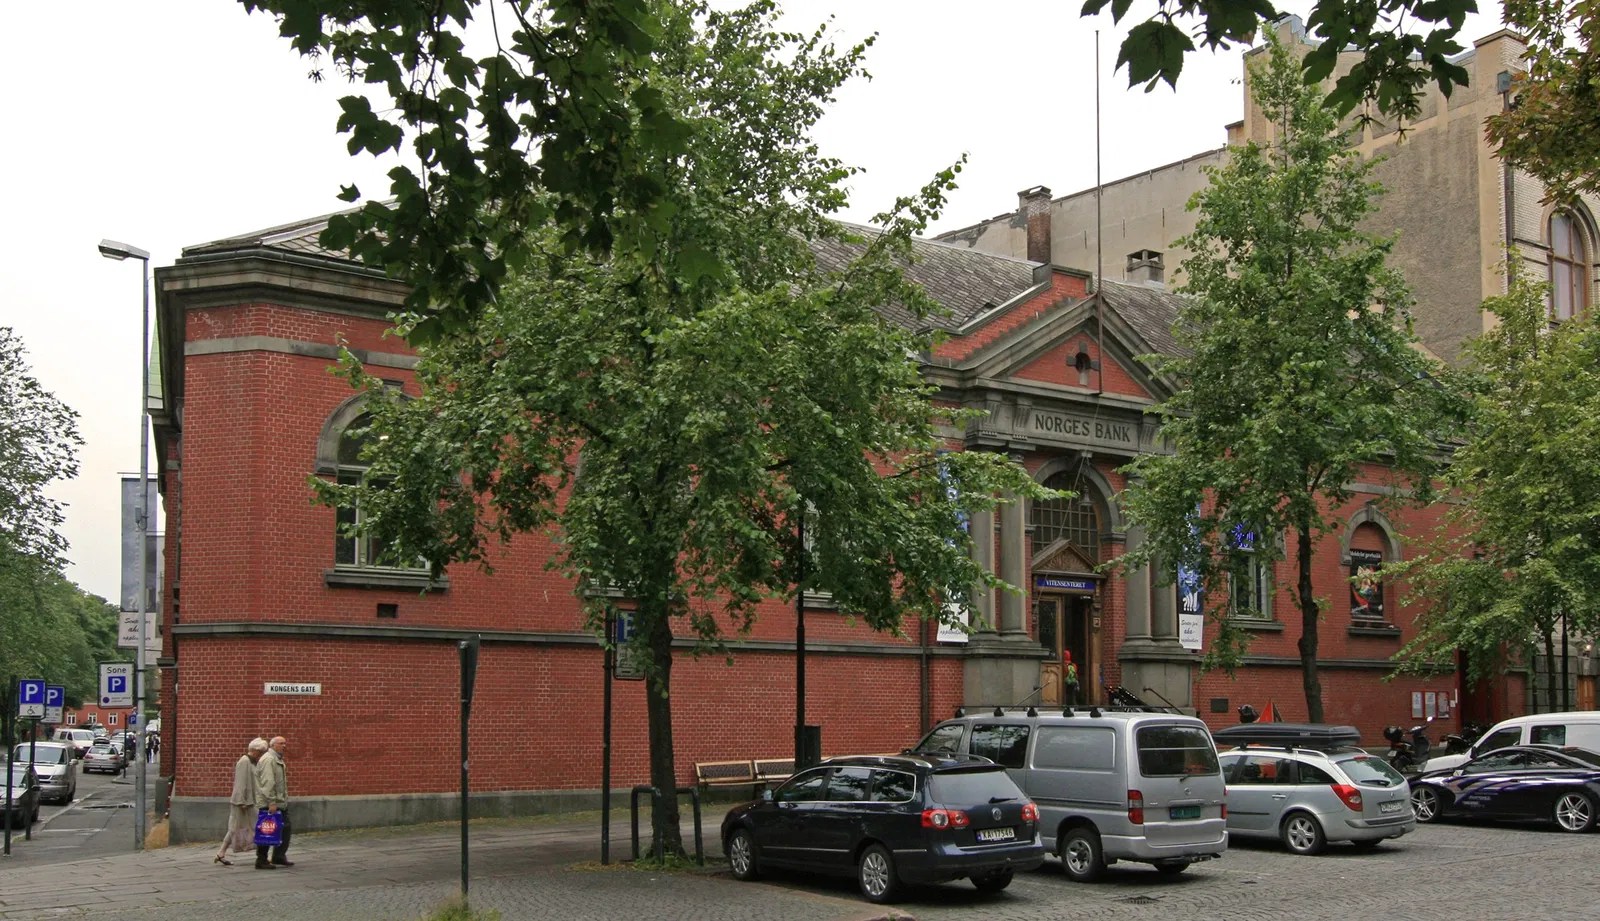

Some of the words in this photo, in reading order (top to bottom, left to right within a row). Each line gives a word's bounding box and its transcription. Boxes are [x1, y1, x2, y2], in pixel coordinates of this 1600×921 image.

[1035, 414, 1090, 437] NORGES
[1095, 423, 1131, 443] BANK
[1045, 579, 1086, 588] VITENSENTERET
[106, 666, 127, 674] Sone
[111, 677, 122, 692] P
[270, 685, 300, 693] KONGENS
[300, 685, 316, 693] GATE
[25, 683, 39, 702] P
[47, 689, 59, 705] P
